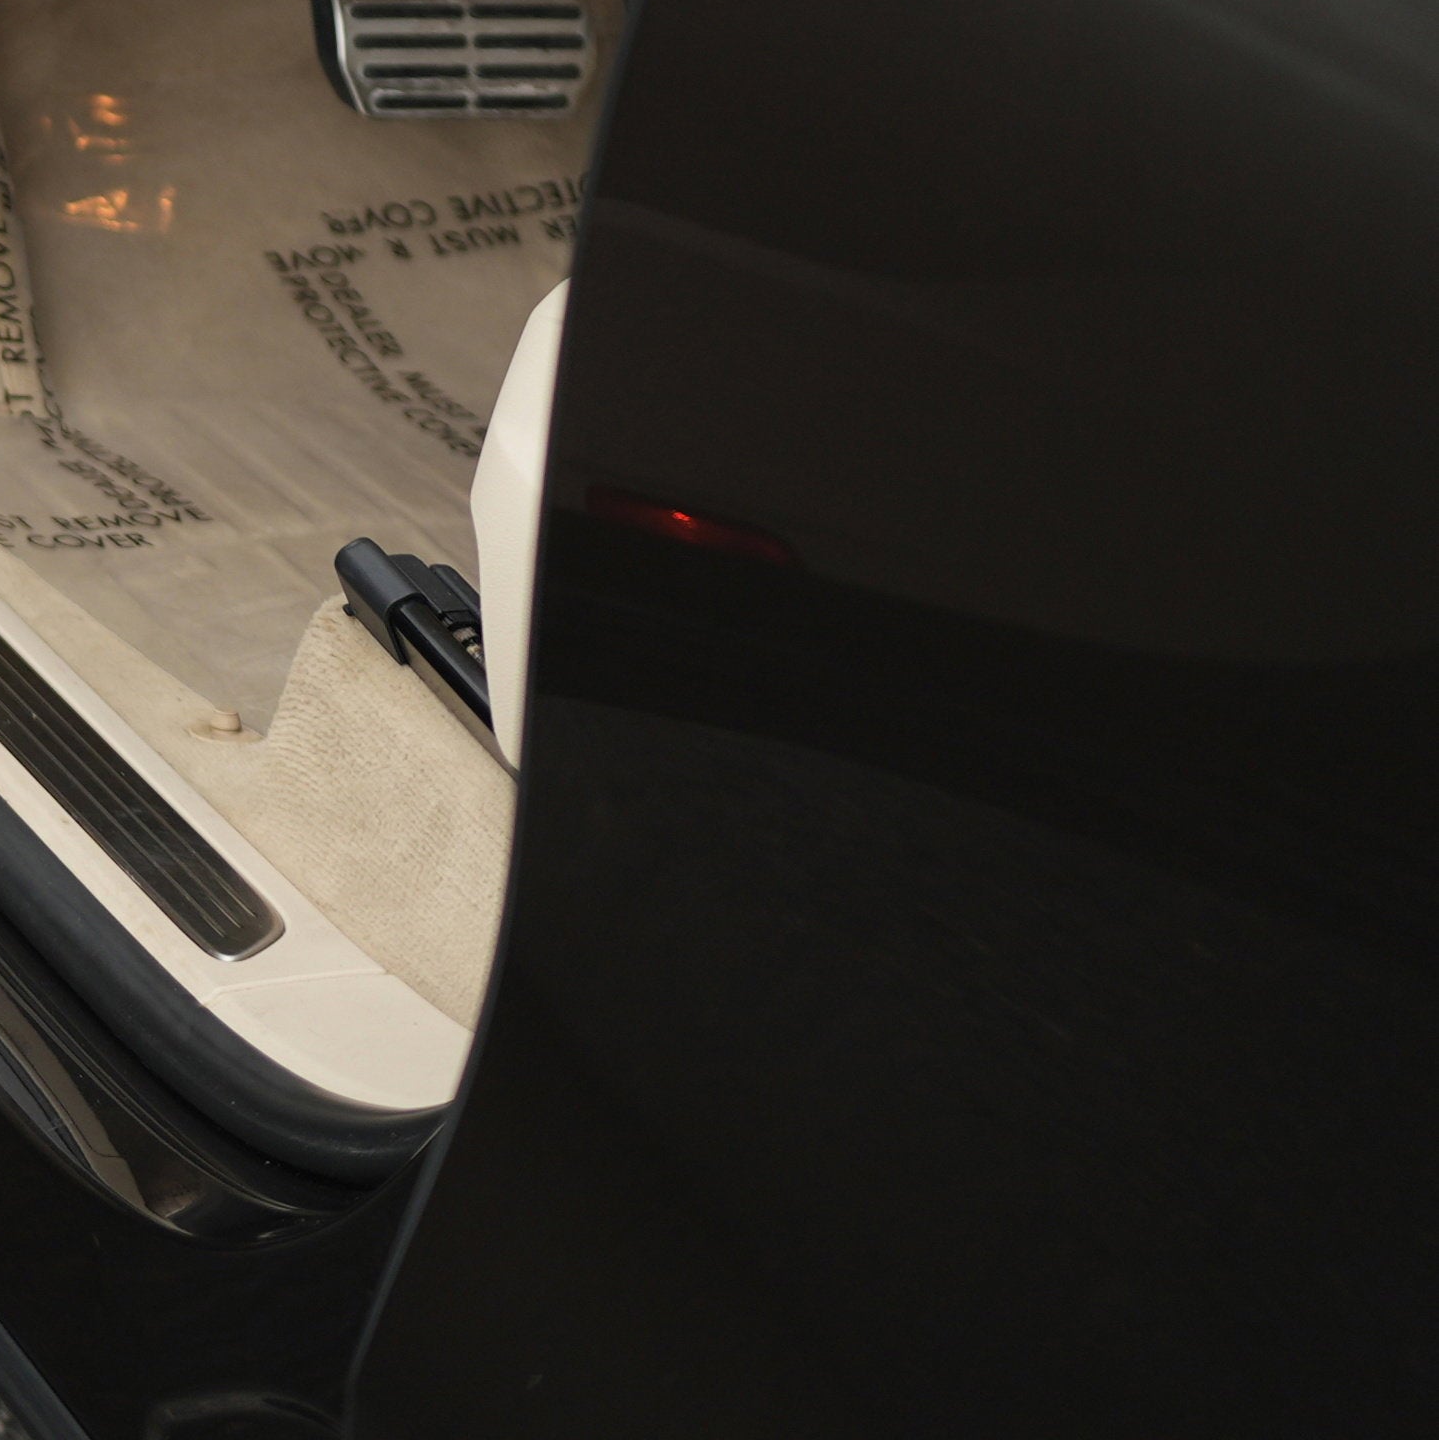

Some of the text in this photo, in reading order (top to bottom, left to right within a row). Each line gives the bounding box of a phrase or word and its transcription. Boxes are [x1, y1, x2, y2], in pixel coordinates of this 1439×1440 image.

[321, 199, 438, 235] COVER
[428, 224, 521, 257] MUST
[50, 506, 214, 531] REMOVE
[27, 531, 155, 550] COVER
